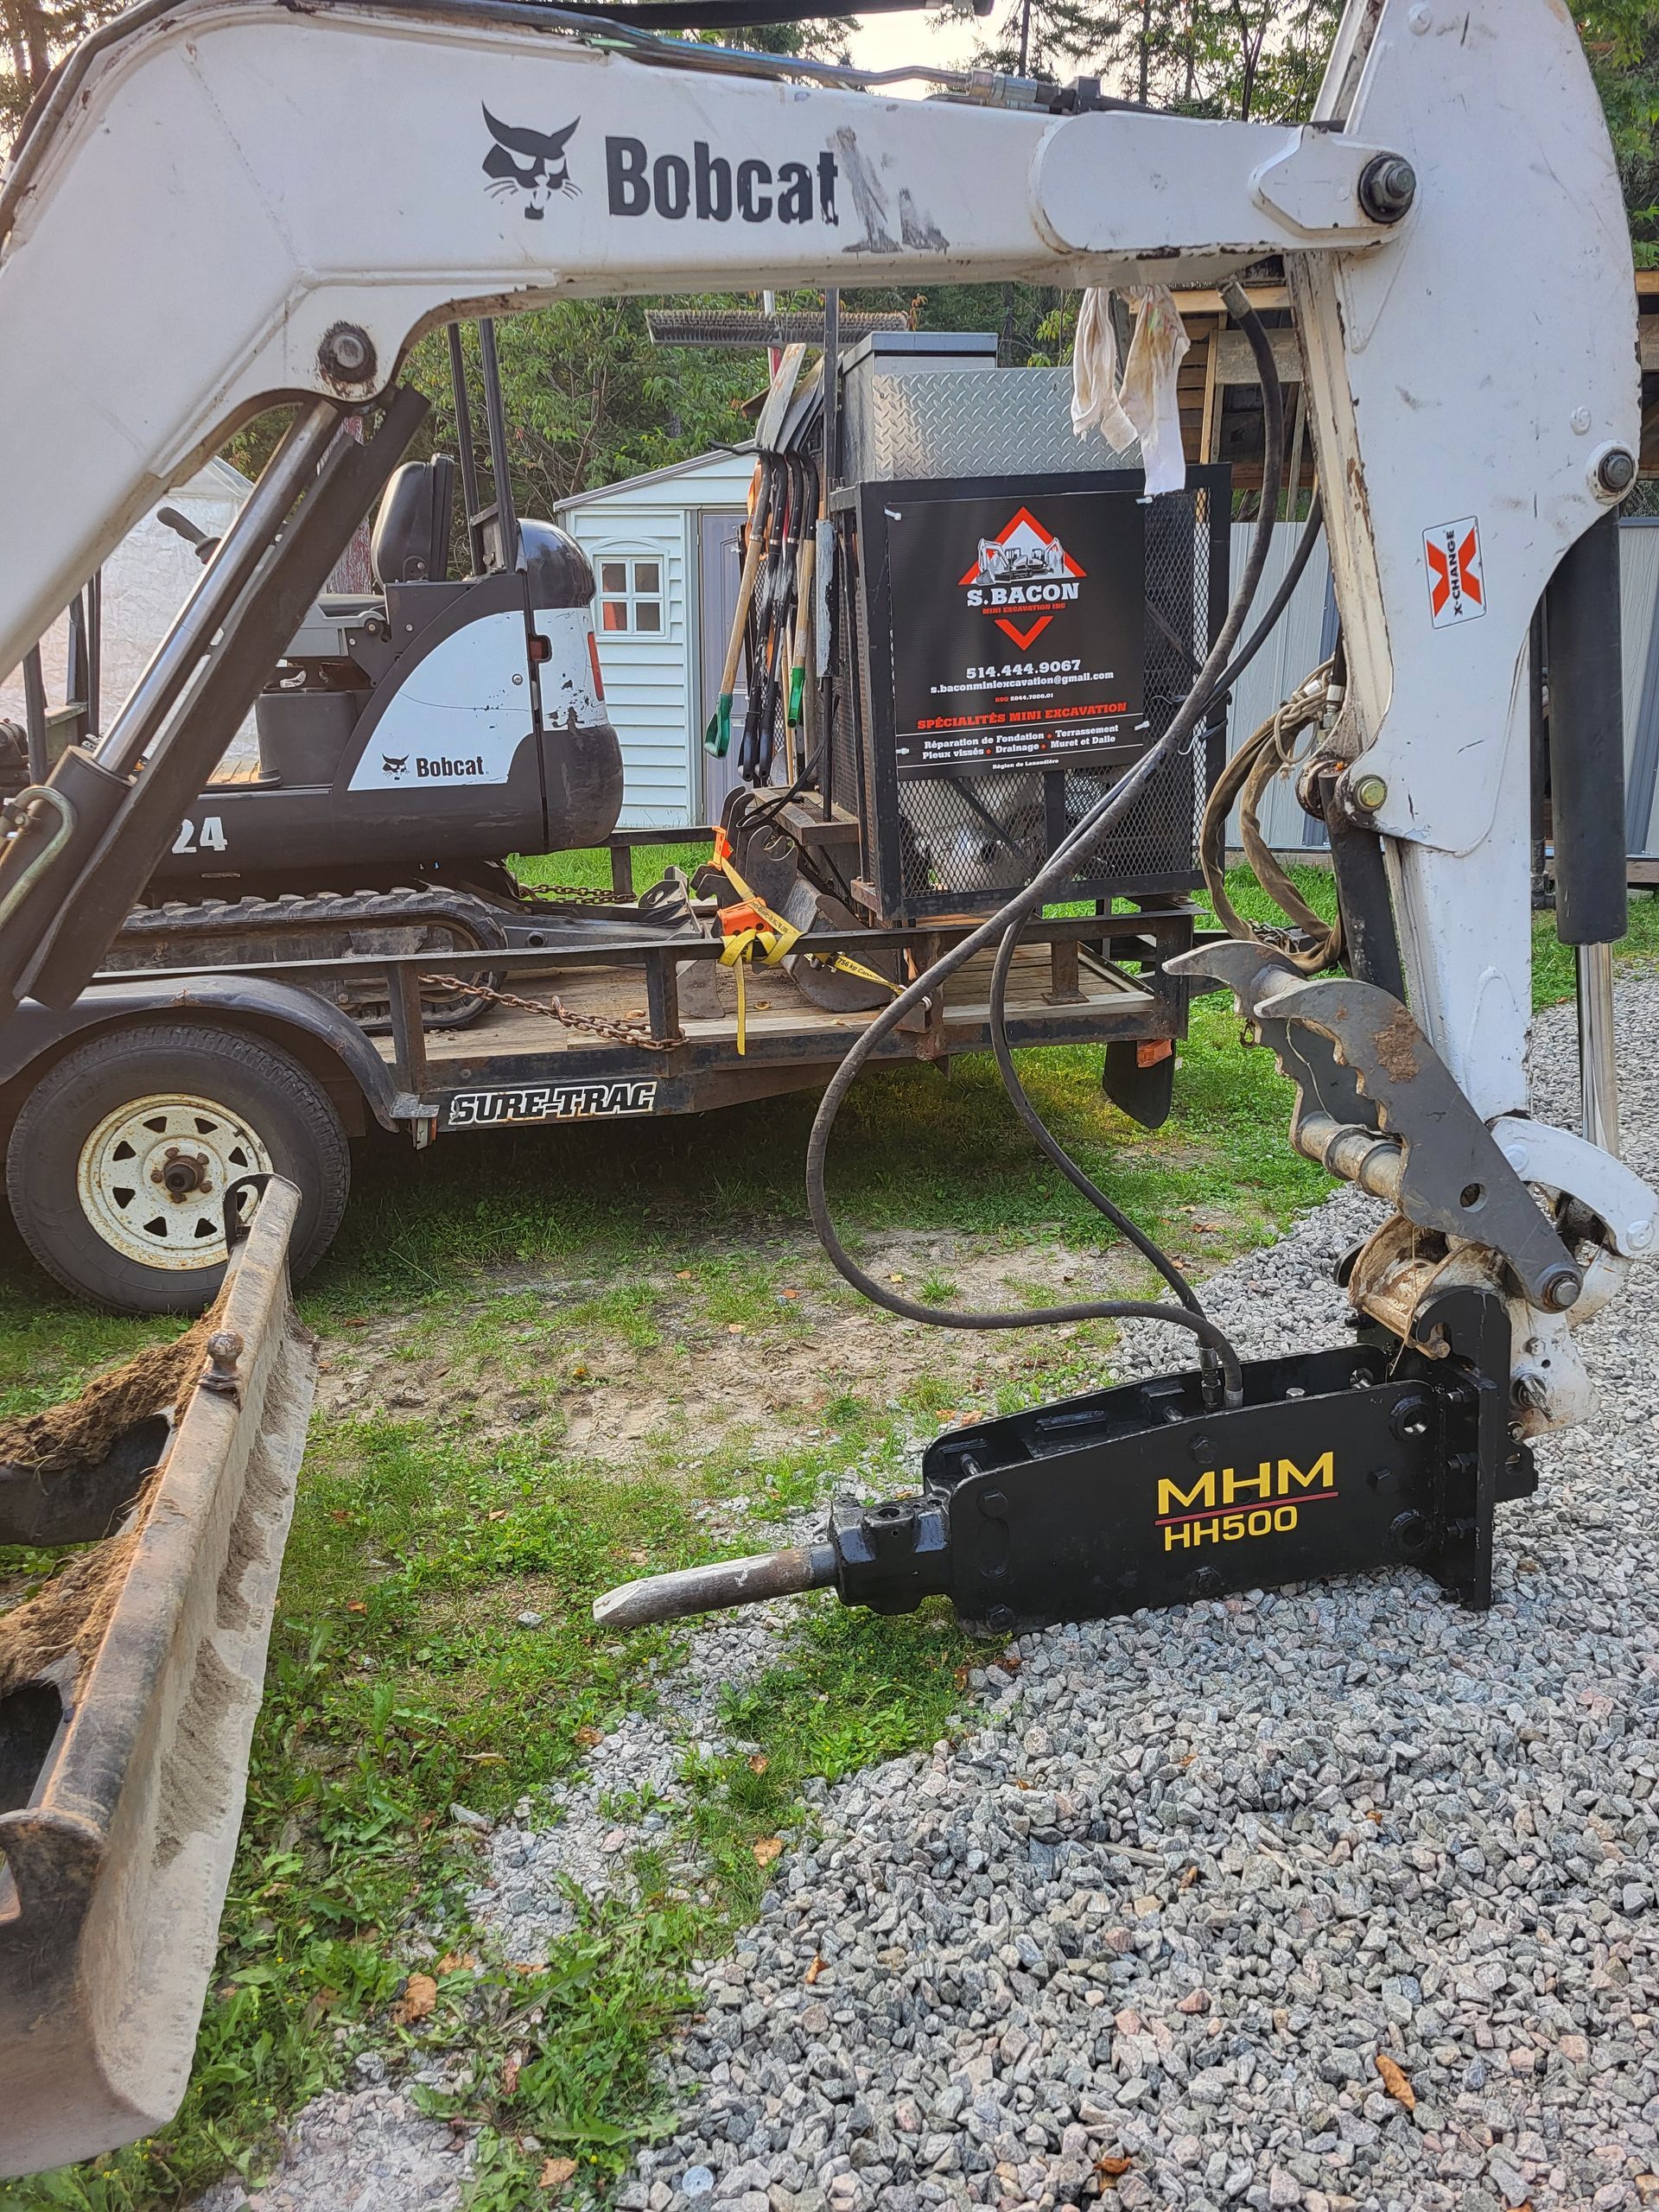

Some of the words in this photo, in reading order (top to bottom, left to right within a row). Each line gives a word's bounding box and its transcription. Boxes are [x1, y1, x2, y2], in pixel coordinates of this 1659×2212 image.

[605, 136, 839, 226] Bobcat
[1446, 530, 1464, 616] X-CHANGE
[1002, 604, 1051, 613] EXCAVATION
[966, 659, 1081, 679] 514.444.9067
[930, 671, 1115, 694] s.baconminiexcavation@gmail.com
[917, 713, 1006, 729] SPÉCIALITÉS
[1008, 709, 1042, 722] MINI
[1045, 702, 1127, 720] EXCAVATION
[922, 750, 950, 760] Pieux
[953, 747, 984, 758] vissés
[995, 743, 1039, 754] Drainage
[1050, 738, 1078, 749] Muret
[1080, 737, 1090, 746] et
[1091, 734, 1116, 745] Dalle
[924, 739, 979, 750] Réparation
[981, 735, 994, 745] de
[996, 732, 1045, 744] Fondation
[1055, 724, 1119, 738] Terrassement
[416, 756, 484, 778] Bobcat
[448, 1081, 658, 1126] SURE-TRAC
[1158, 1451, 1334, 1516] MHM
[1164, 1505, 1298, 1552] HH500
